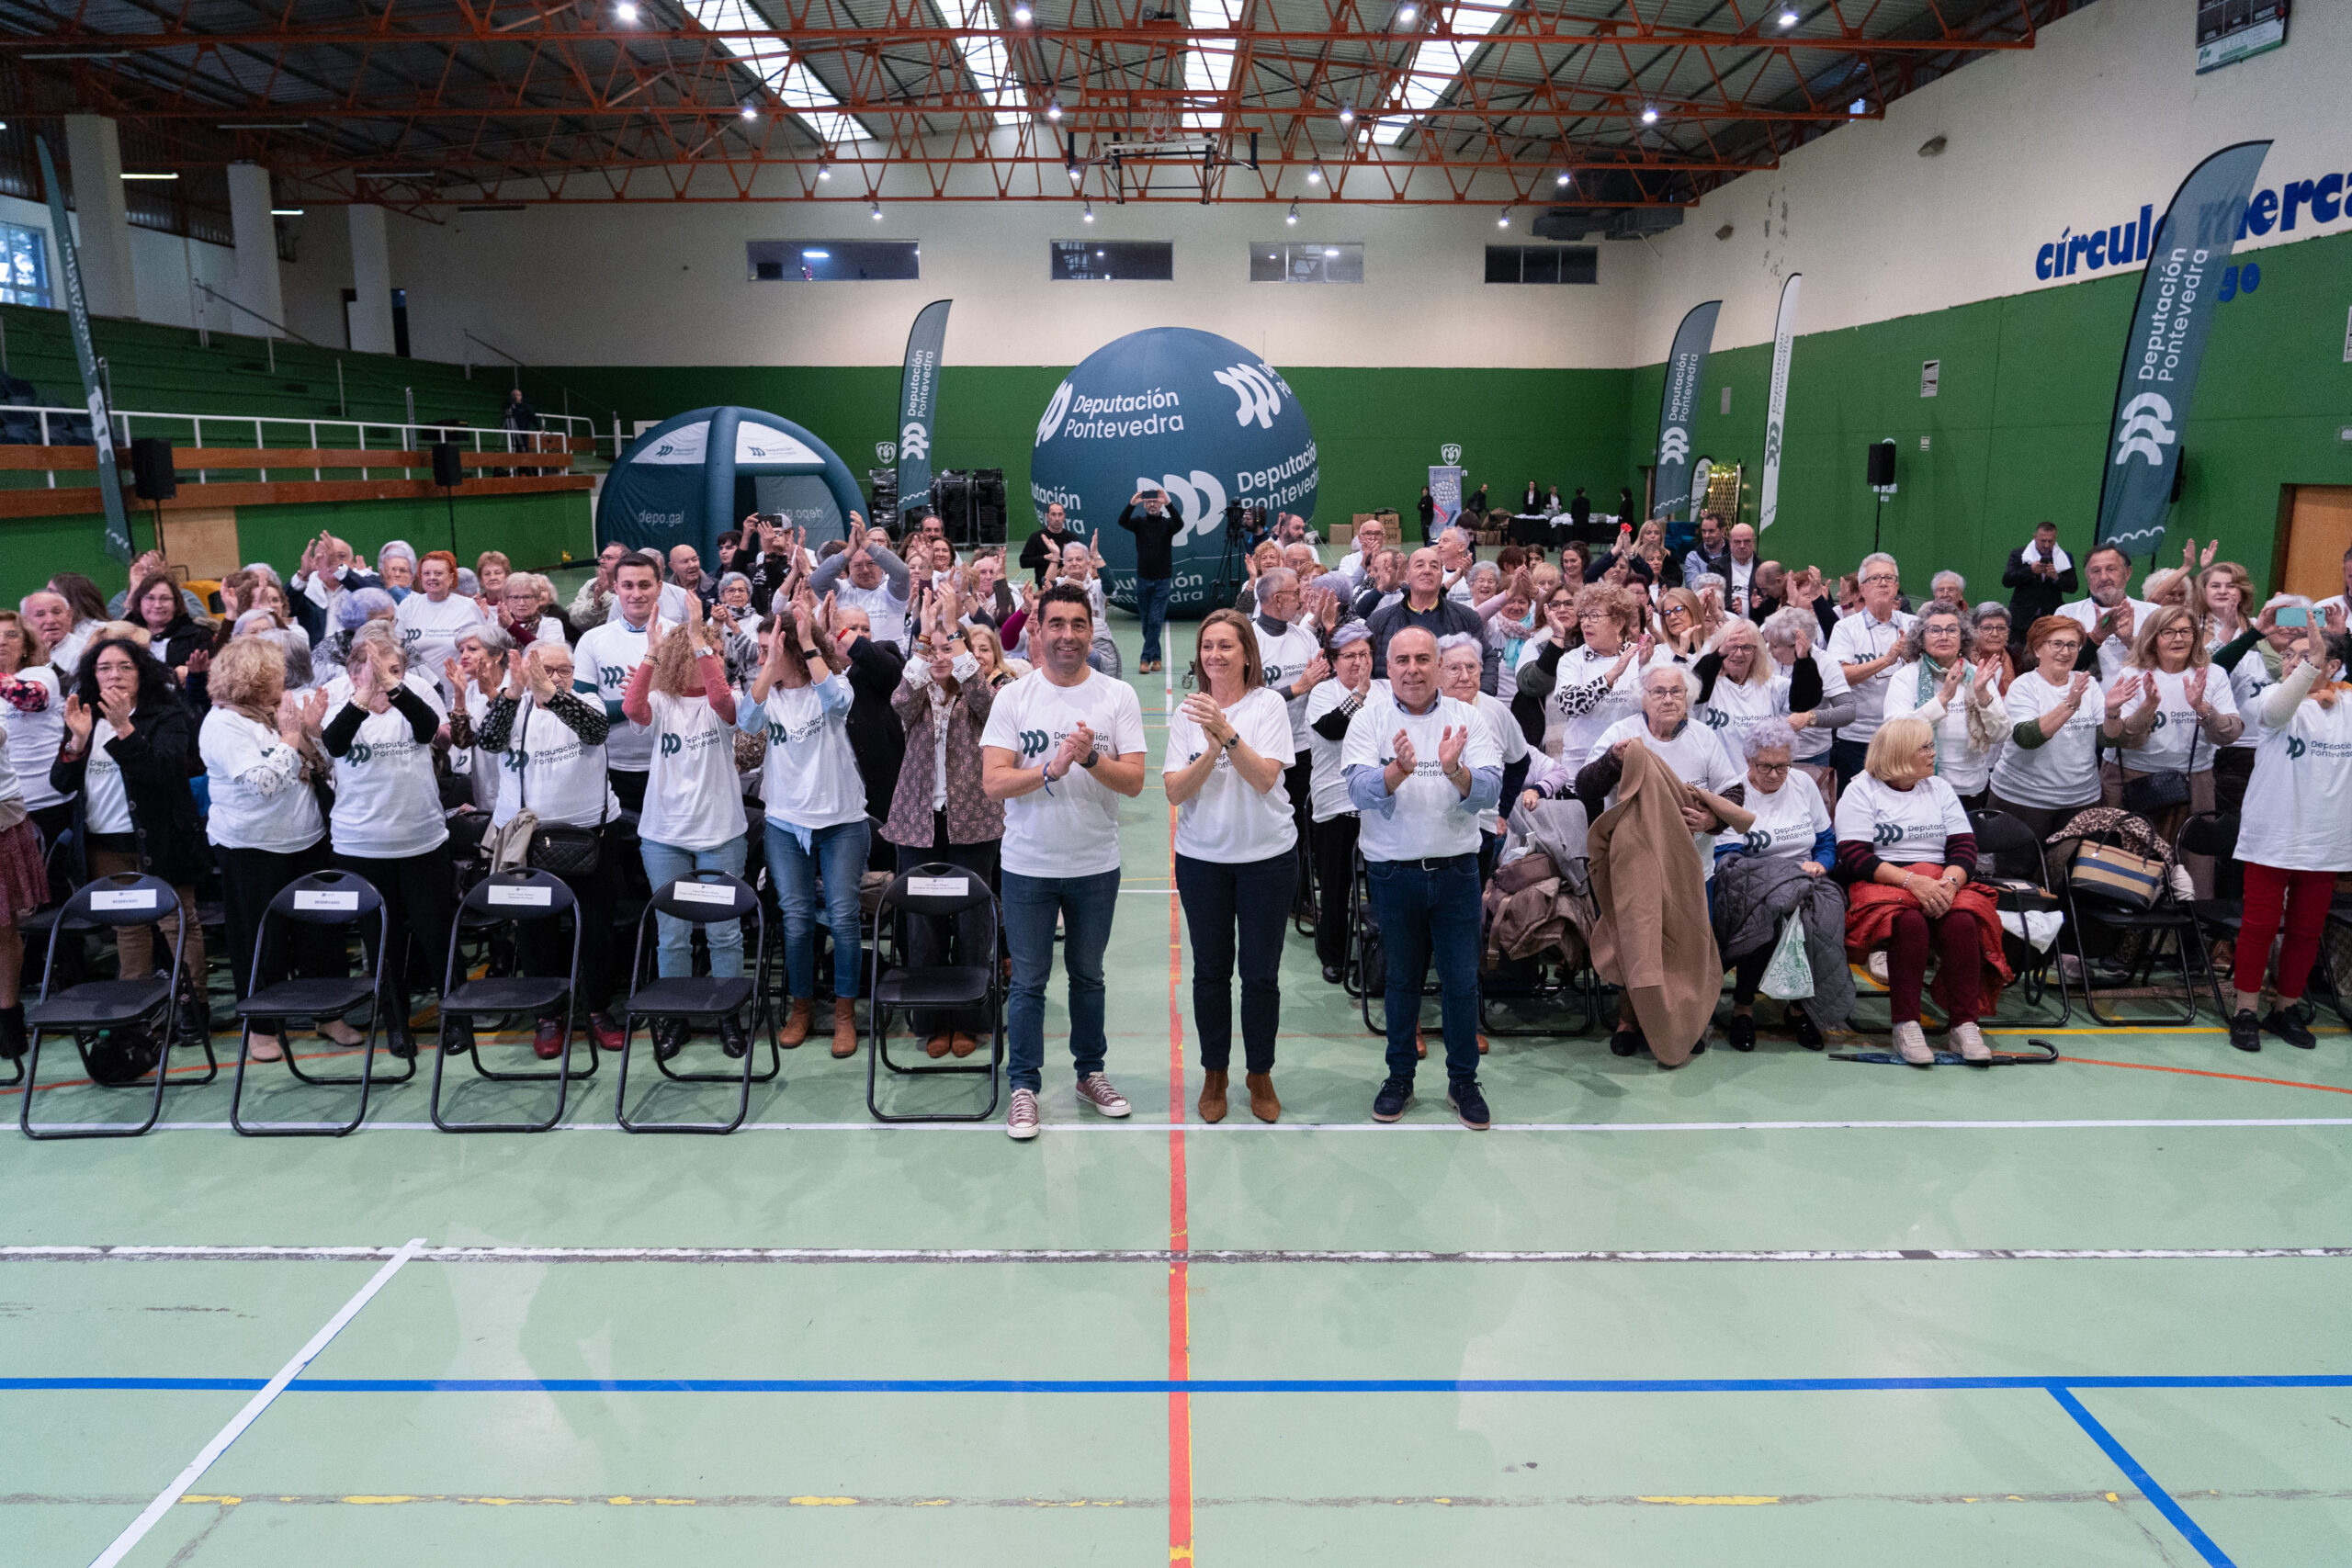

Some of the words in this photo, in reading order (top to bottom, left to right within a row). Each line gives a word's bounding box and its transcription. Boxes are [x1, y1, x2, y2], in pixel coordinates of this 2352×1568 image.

[2138, 247, 2188, 380] Deputación
[2157, 248, 2209, 382] Pontevedra
[907, 350, 923, 417] Deputación
[917, 351, 933, 417] Pontevedra
[1668, 353, 1688, 422] Deputación
[1679, 354, 1699, 423] Pontevedra
[1072, 387, 1180, 420] Deputación
[1064, 413, 1184, 438] Pontevedra
[639, 510, 684, 527] depo.gal
[2170, 710, 2196, 718] Deput
[534, 741, 582, 758] Deputación
[534, 749, 584, 765] Pontevedra
[1413, 769, 1443, 777] Pontev
